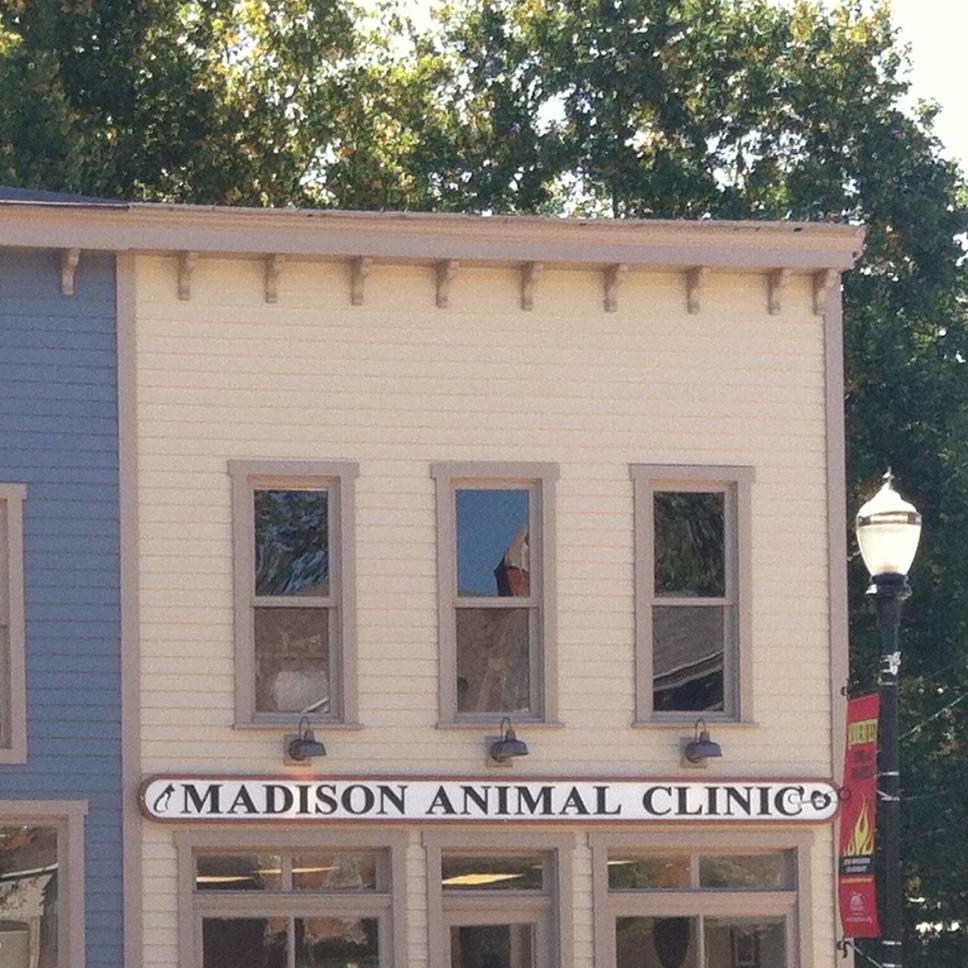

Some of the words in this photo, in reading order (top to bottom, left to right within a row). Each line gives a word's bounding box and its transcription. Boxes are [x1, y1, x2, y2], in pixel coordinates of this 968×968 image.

[181, 784, 409, 815] MADISON
[425, 785, 622, 816] ANIMAL
[642, 785, 805, 816] CLINIC
